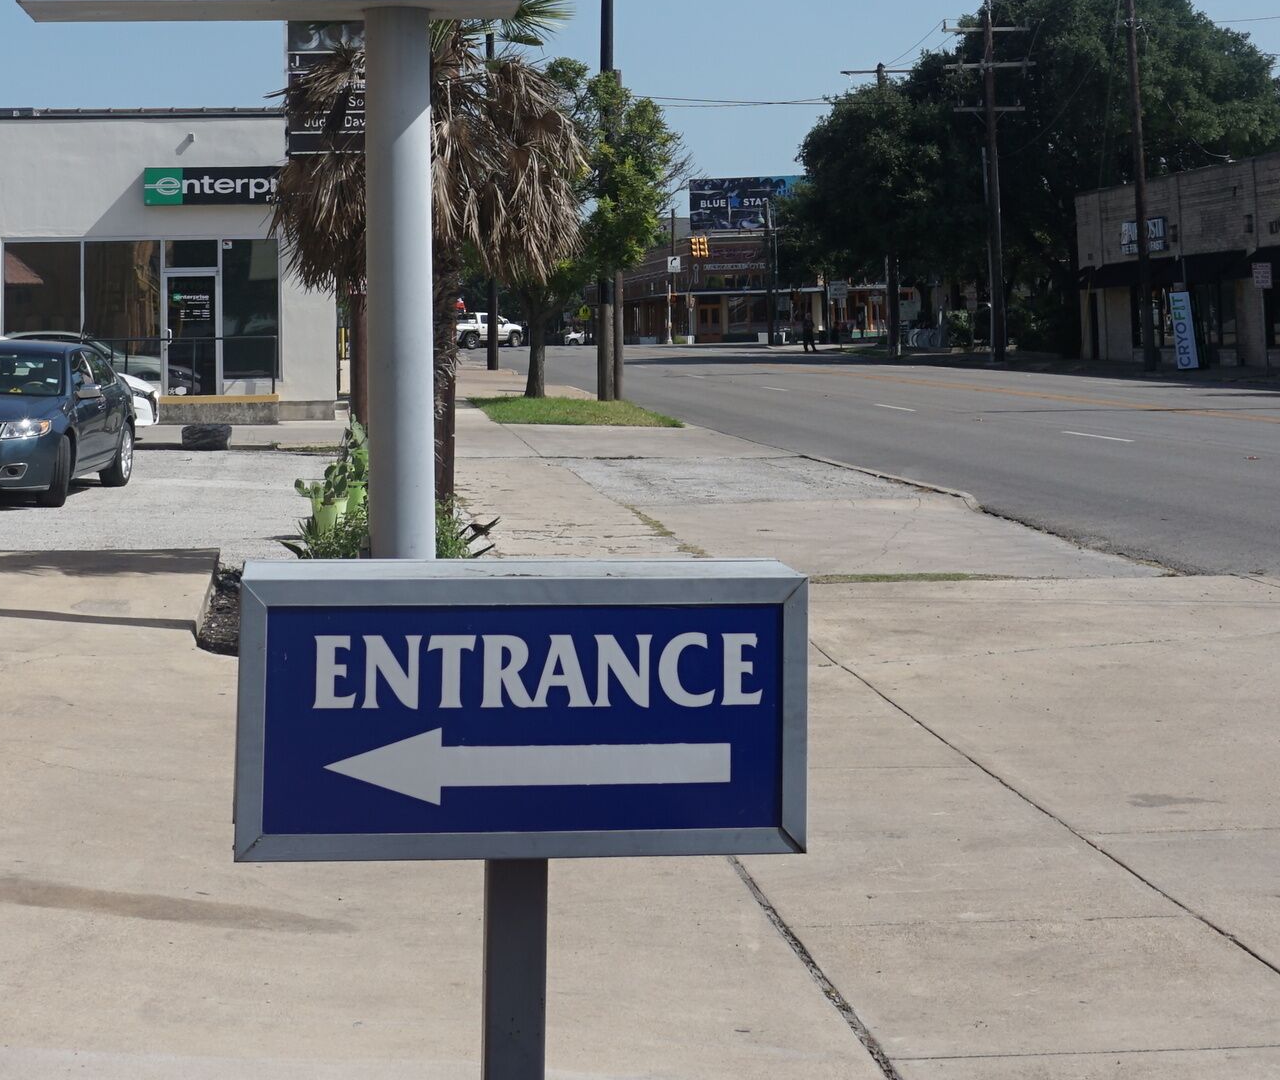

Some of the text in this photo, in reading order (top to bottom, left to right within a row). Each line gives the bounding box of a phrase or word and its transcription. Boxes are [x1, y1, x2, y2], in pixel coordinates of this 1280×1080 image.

[152, 175, 280, 199] enterpr
[700, 199, 726, 208] BLUE
[1172, 296, 1192, 367] CRYOFIT
[312, 632, 763, 710] ENTRANCE
